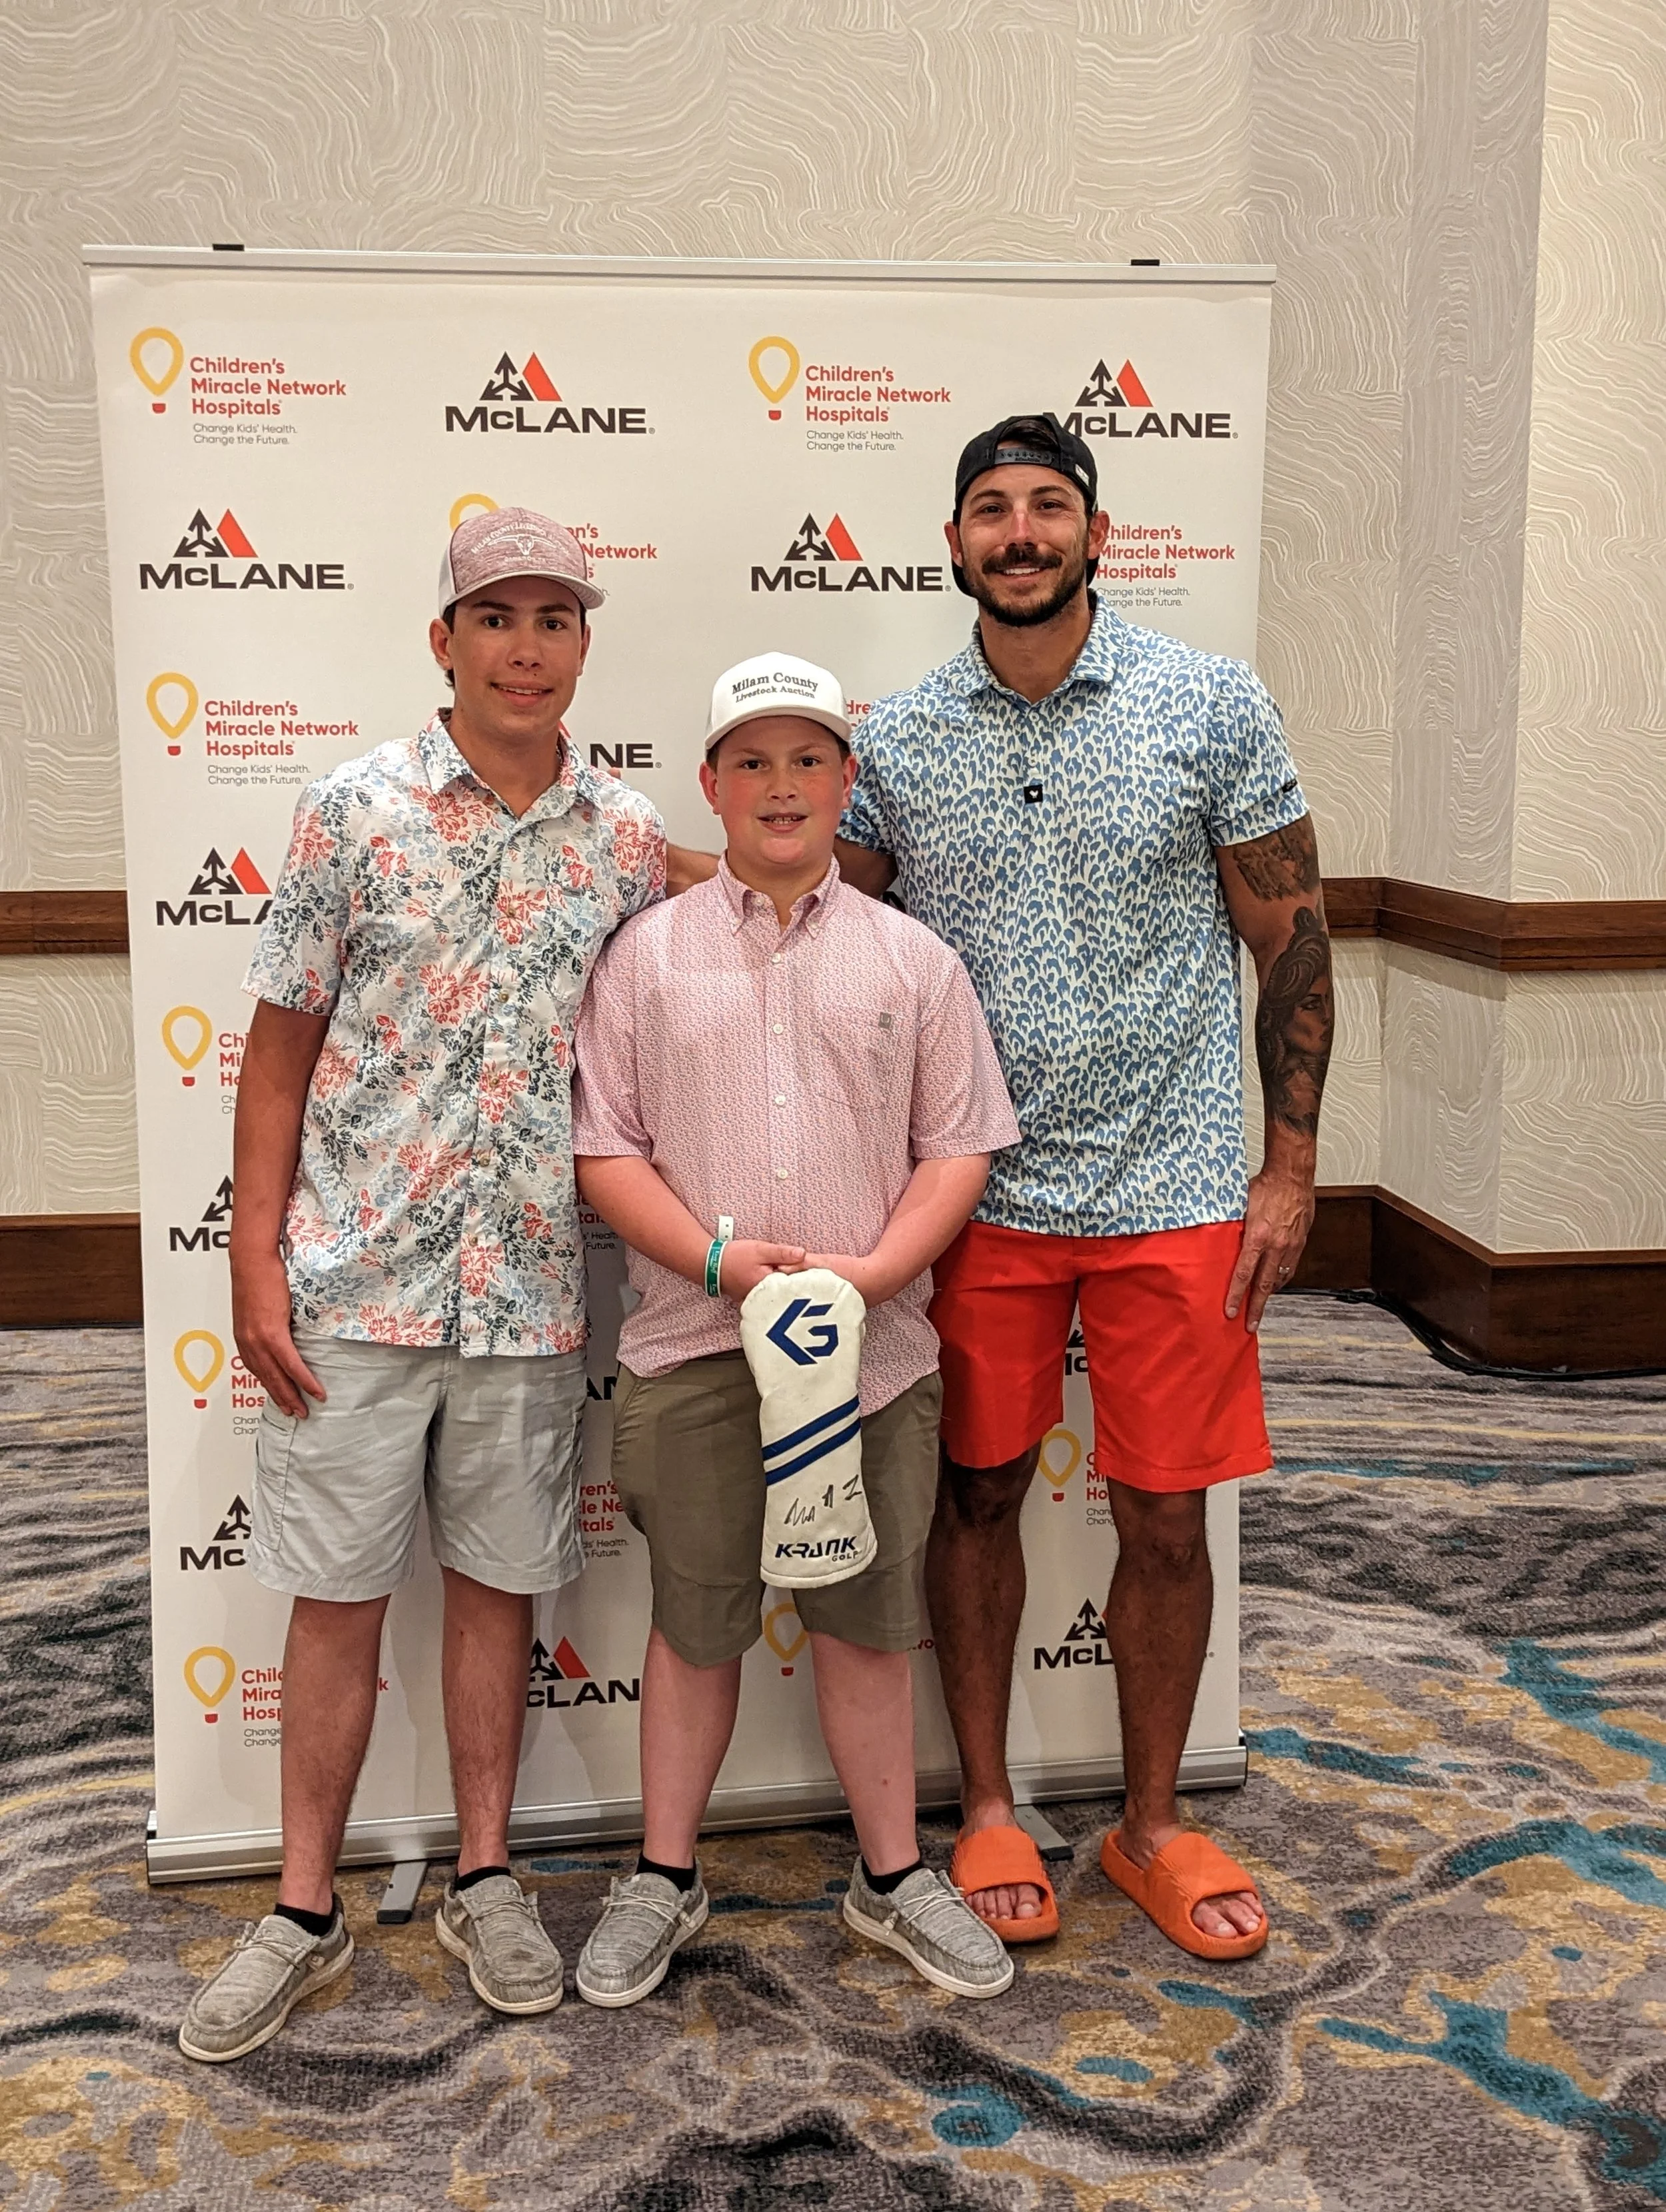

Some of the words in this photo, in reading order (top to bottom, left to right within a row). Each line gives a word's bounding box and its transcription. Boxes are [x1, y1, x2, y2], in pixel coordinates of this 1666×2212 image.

[190, 357, 285, 374] Children's
[806, 366, 894, 382] Children's
[191, 378, 261, 394] Miracle
[267, 379, 347, 396] Network
[806, 386, 872, 401] Miracle
[877, 386, 951, 402] Network
[192, 398, 281, 418] Hospitals
[806, 406, 889, 424] Hospitals
[193, 423, 233, 435] Change
[237, 424, 259, 433] Kids'
[263, 424, 297, 434] Health.
[806, 430, 844, 440] Change
[871, 431, 904, 440] Health.
[194, 434, 234, 445] Change
[238, 435, 253, 444] the
[257, 436, 289, 444] Future.
[806, 441, 844, 452] Change
[866, 442, 896, 450] Future.
[1106, 525, 1182, 540] hildren's
[1099, 544, 1160, 559] Miracle
[1166, 545, 1235, 560] Network
[1096, 564, 1177, 582] Hospitals
[1159, 587, 1190, 596] Health.
[732, 674, 769, 694] Milam
[773, 672, 818, 692] County
[736, 686, 777, 703] Livestock
[780, 686, 815, 699] Auction
[205, 700, 298, 716] Children's
[206, 720, 275, 736] Miracle
[281, 720, 359, 736] Network
[207, 740, 294, 760] Hospitals
[208, 765, 248, 776] Change
[251, 765, 273, 774] Kids'
[275, 765, 310, 774] Health.
[209, 776, 248, 786] Change
[270, 776, 302, 784] Future.
[832, 1552, 859, 1562] GOLF
